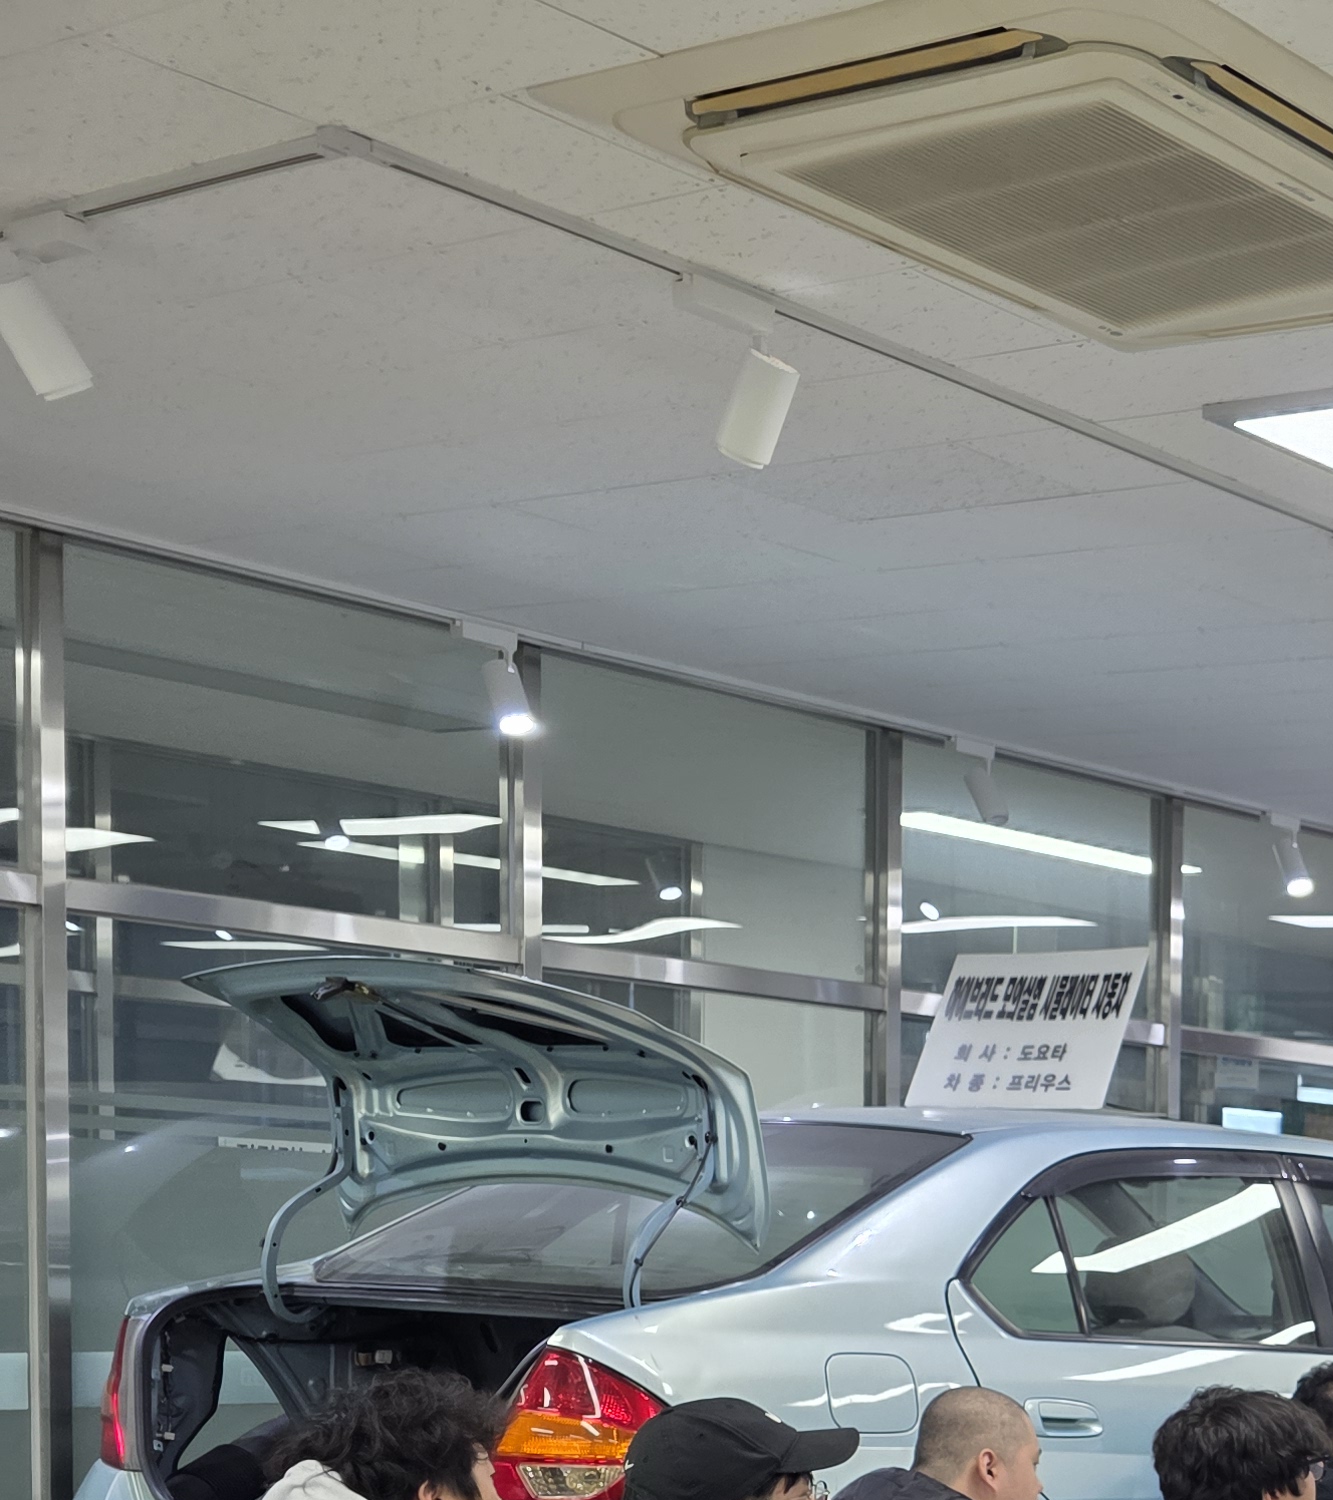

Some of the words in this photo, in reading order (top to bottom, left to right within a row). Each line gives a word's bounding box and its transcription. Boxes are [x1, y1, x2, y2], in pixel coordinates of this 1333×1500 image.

[1017, 1042, 1068, 1062] 도요타
[943, 1073, 961, 1092] 차
[1006, 1073, 1072, 1092] 프리우스
